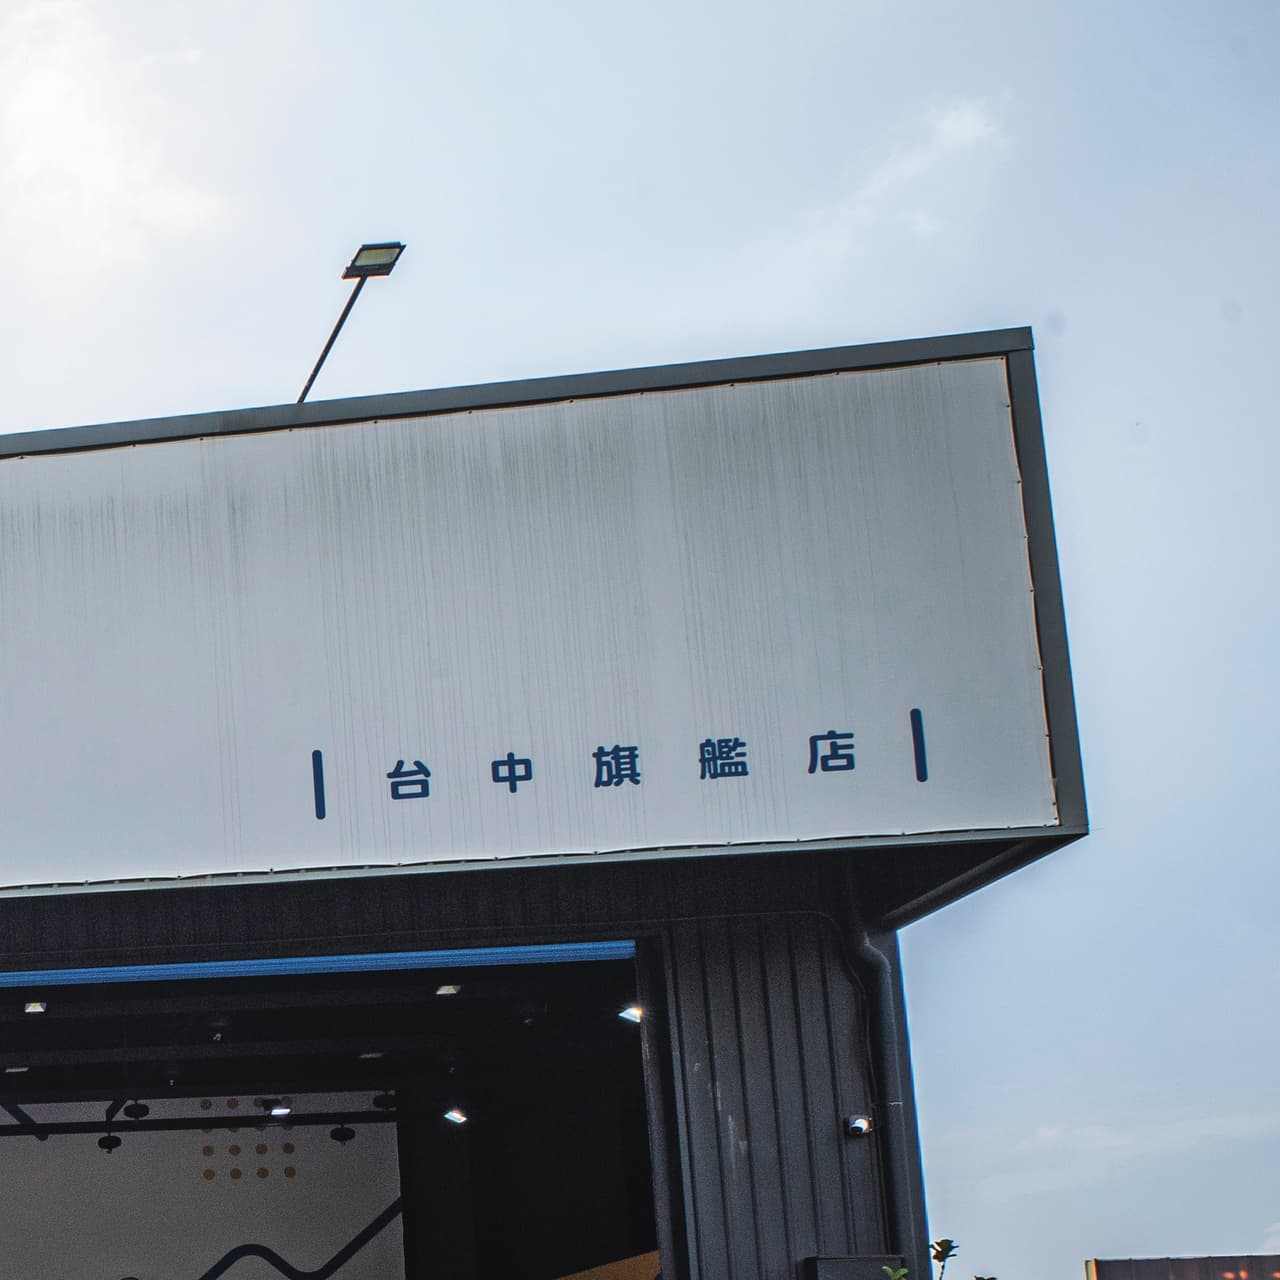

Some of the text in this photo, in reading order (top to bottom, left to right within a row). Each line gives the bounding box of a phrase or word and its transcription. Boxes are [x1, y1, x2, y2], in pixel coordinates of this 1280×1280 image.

[386, 729, 856, 802] 台中旗艦店
